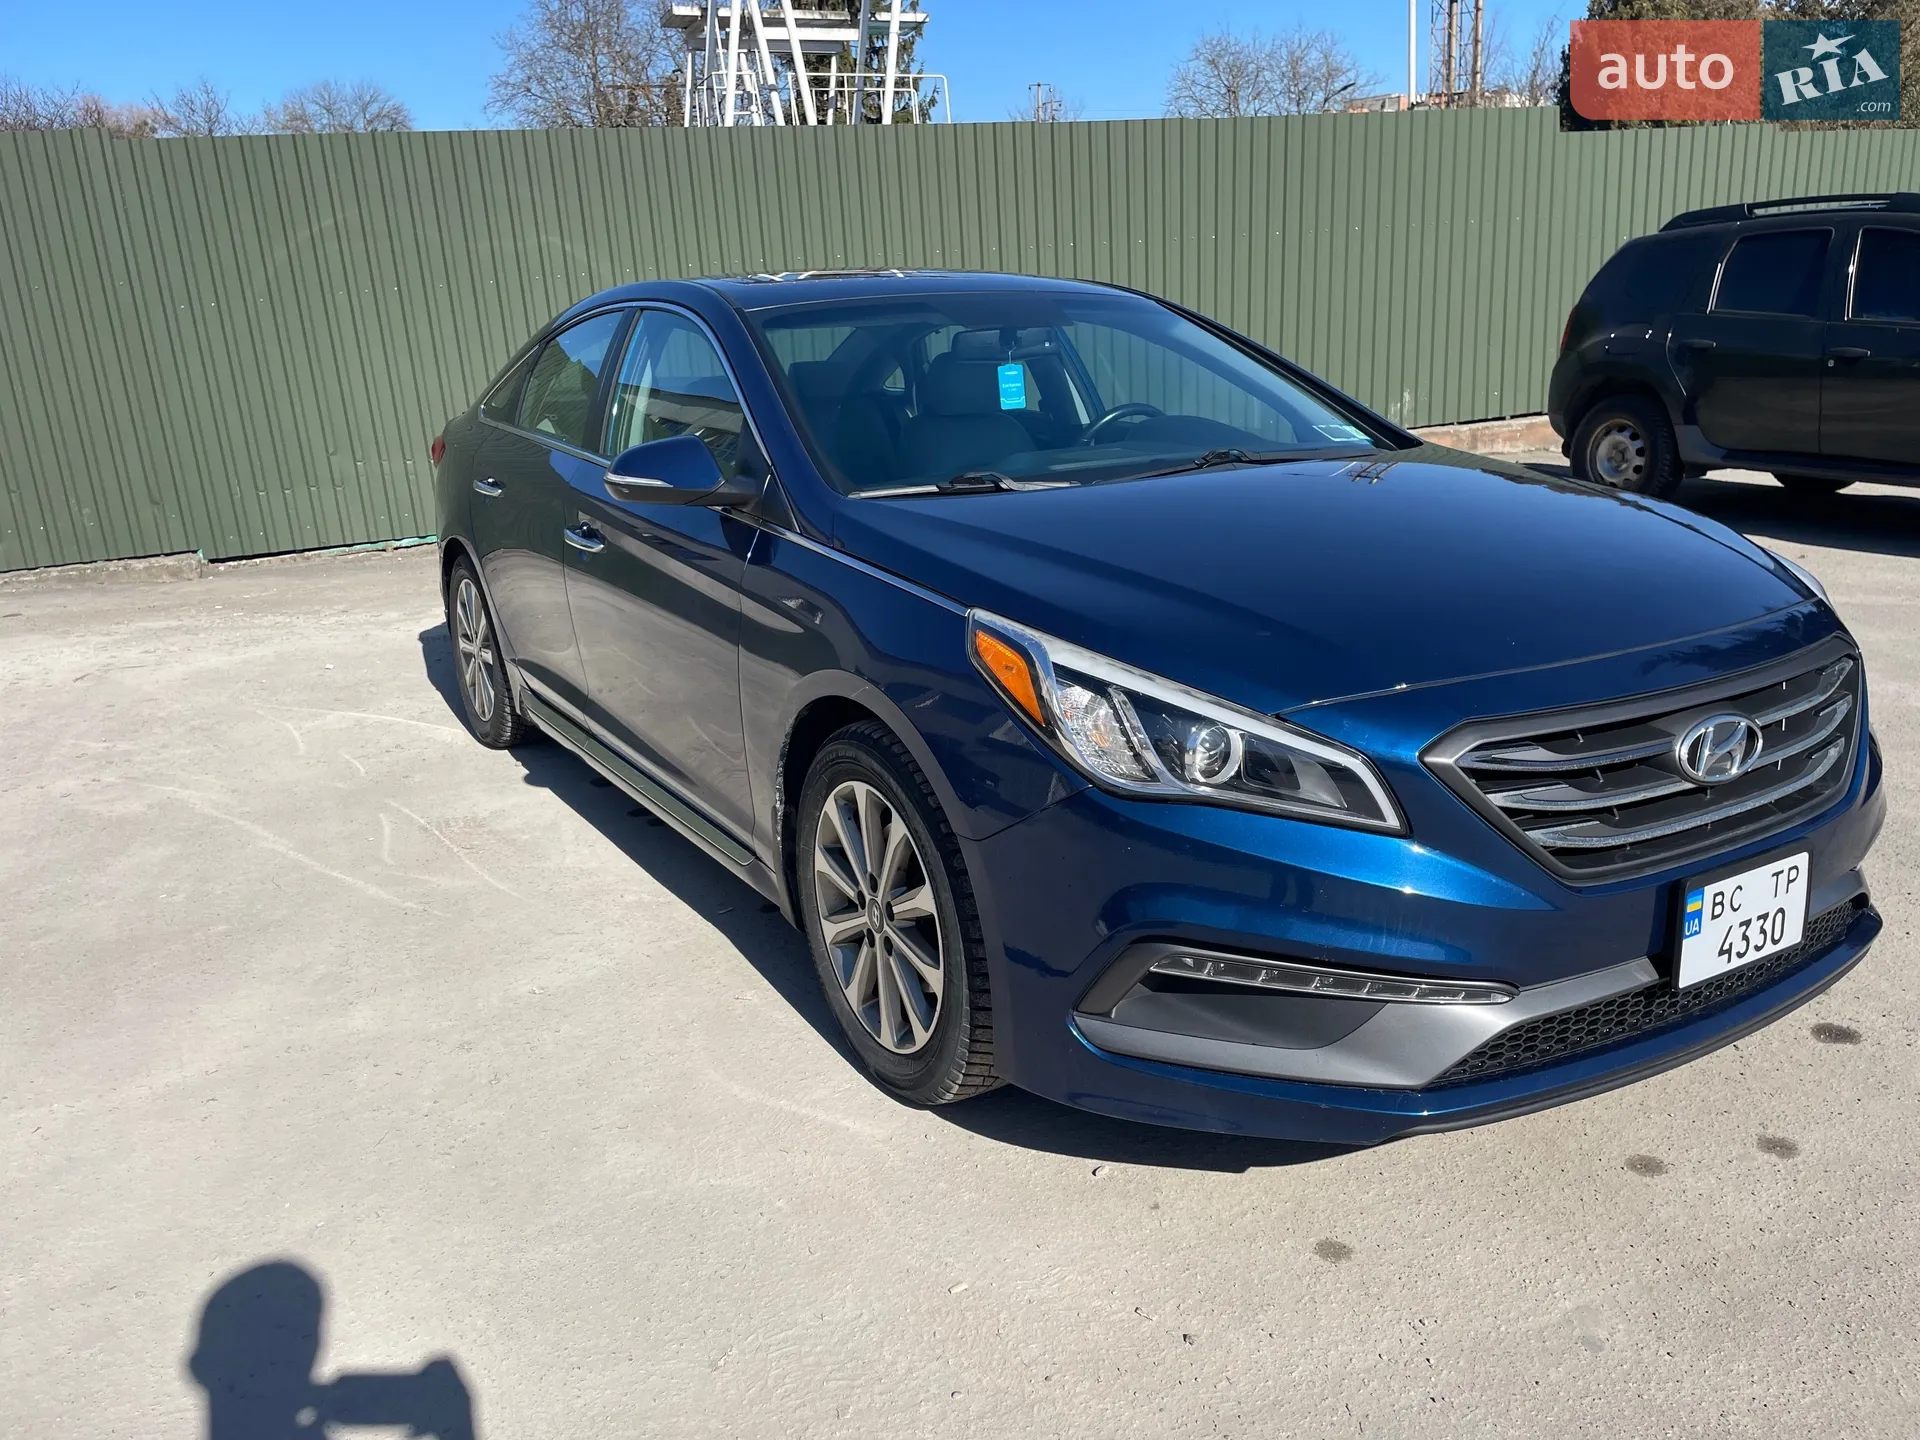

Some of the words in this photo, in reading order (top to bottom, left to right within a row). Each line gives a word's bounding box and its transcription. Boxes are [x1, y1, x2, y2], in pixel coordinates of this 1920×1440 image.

[1710, 885, 1743, 921] BC
[1771, 865, 1799, 898] TP
[1685, 919, 1700, 936] UA
[1717, 907, 1786, 964] 4330
